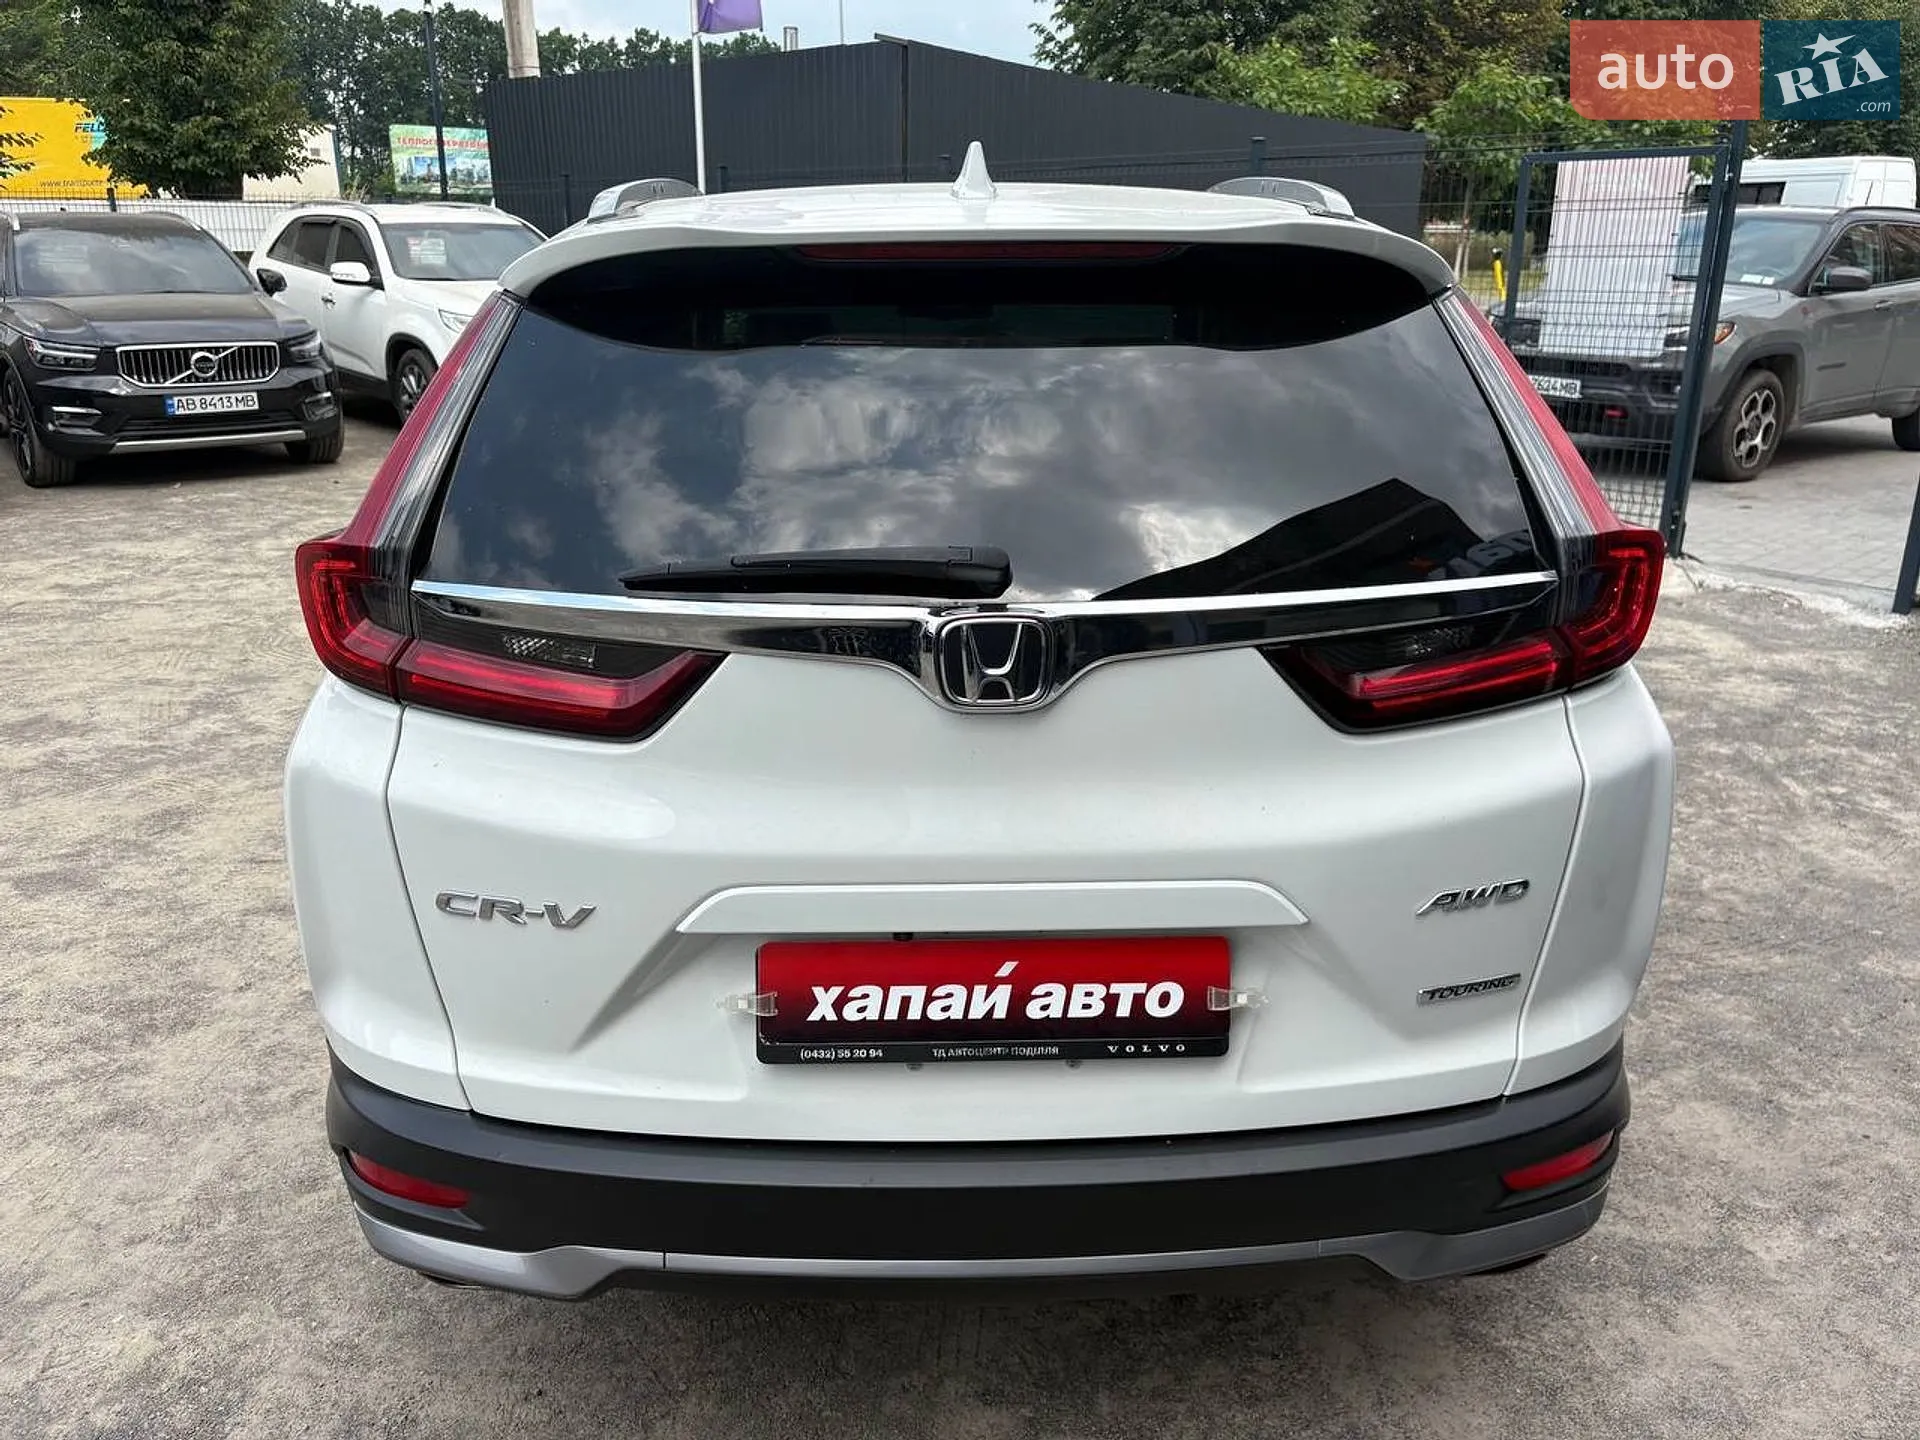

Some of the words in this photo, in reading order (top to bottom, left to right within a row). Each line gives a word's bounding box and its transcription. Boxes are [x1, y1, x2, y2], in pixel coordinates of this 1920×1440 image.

[177, 398, 197, 411] AB
[199, 396, 234, 410] 8413
[235, 395, 257, 408] MB
[435, 890, 597, 928] CR-V
[1415, 879, 1530, 916] AWD
[1024, 981, 1184, 1018] авто
[1420, 974, 1520, 1001] TOURING
[800, 1048, 835, 1061] (0432)
[853, 1048, 867, 1058] 20
[868, 1048, 883, 1058] 94
[1107, 1043, 1186, 1053] VOLVO
